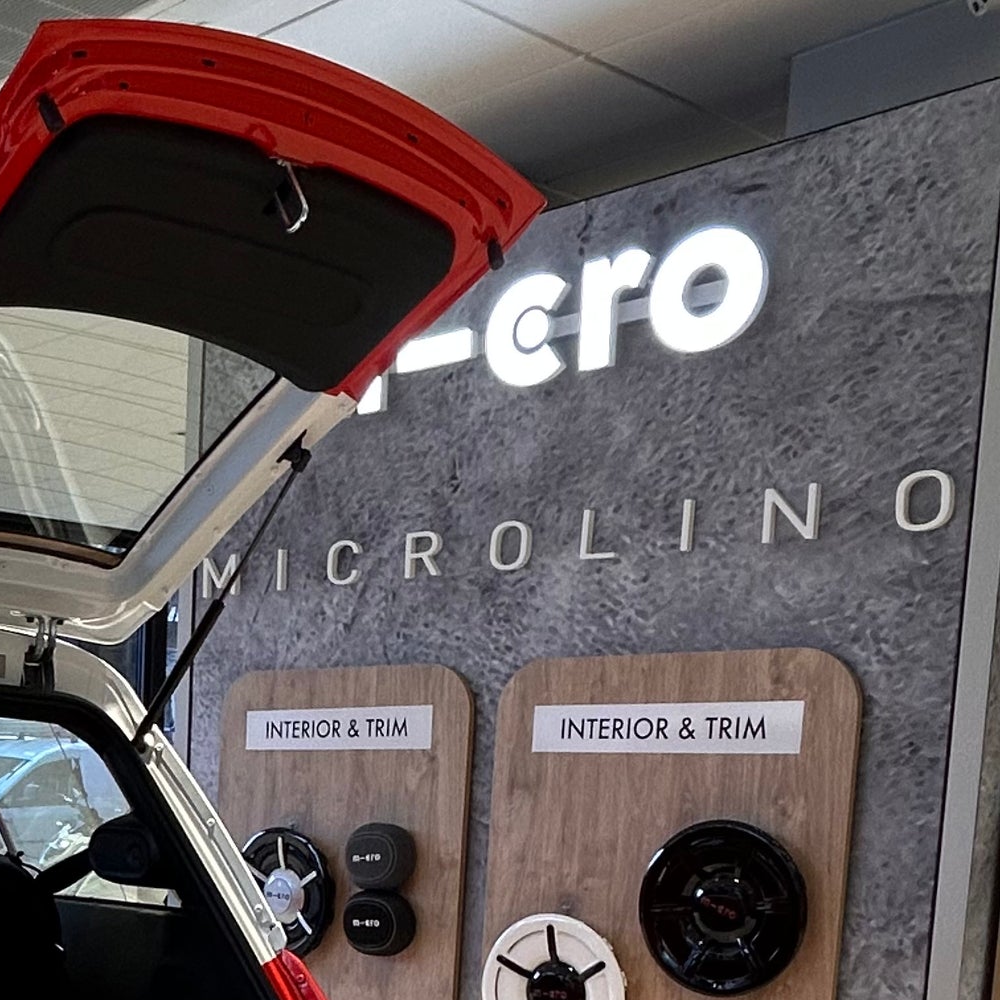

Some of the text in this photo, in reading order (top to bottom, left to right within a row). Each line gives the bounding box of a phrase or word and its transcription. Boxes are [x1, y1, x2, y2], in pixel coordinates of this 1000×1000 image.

[357, 225, 768, 415] -cro
[201, 469, 956, 599] MICROLINO
[265, 717, 408, 739] INTERIOR & TRIM
[560, 715, 767, 740] INTERIOR & TRIM
